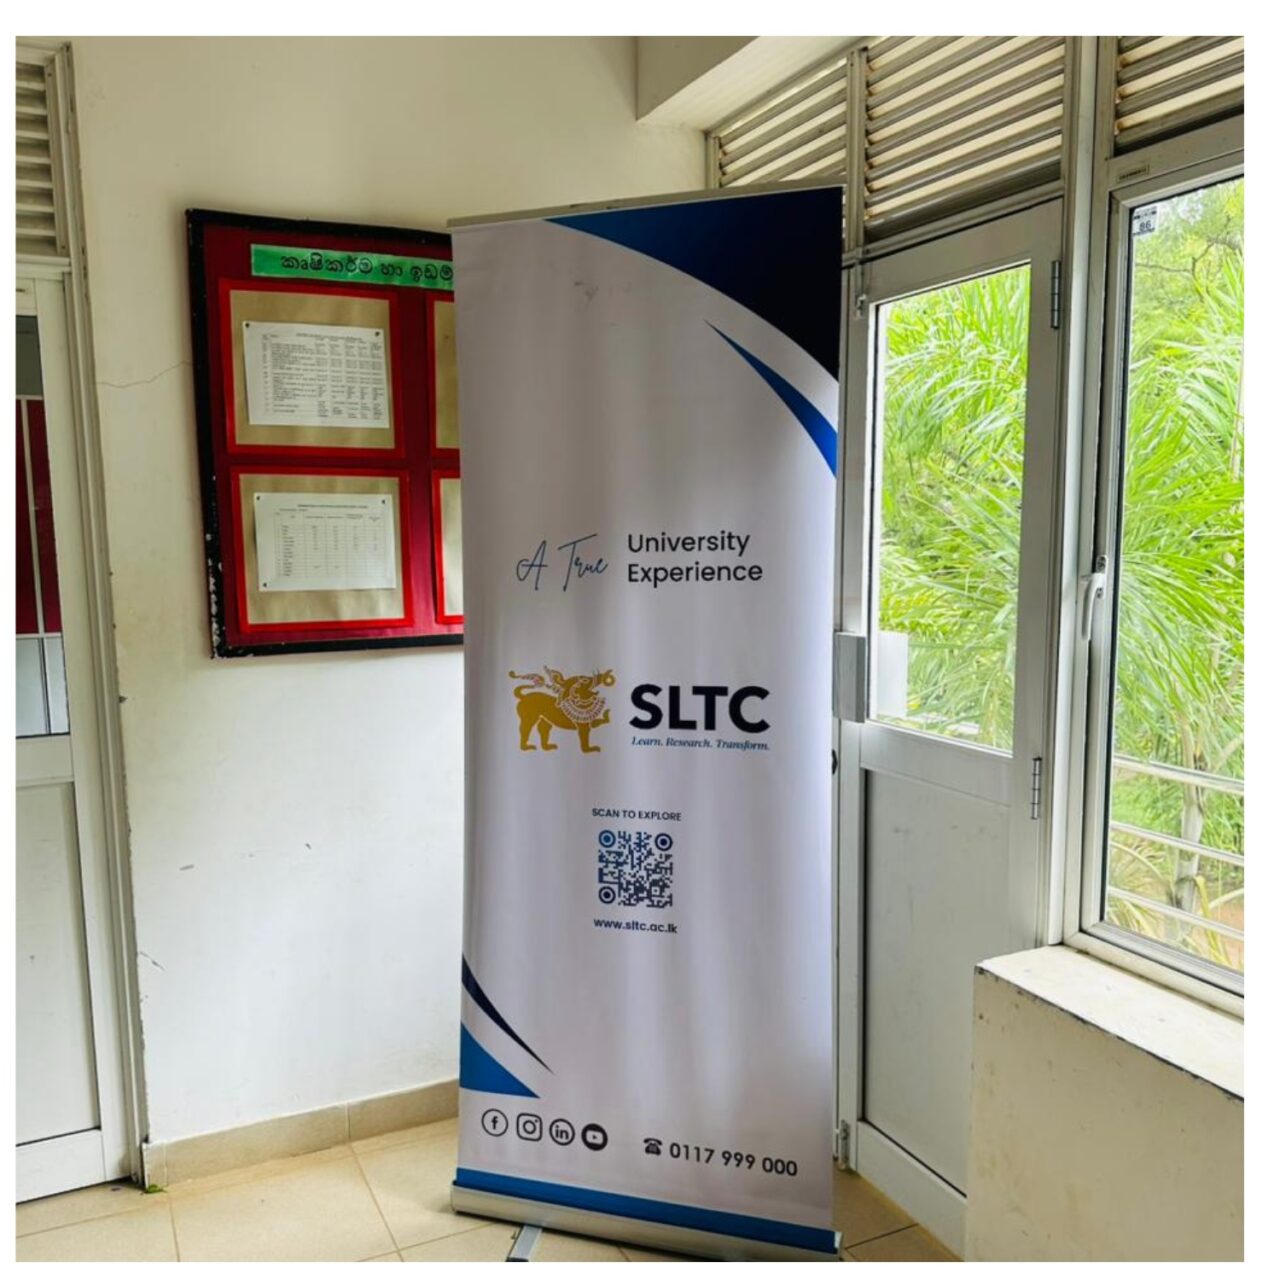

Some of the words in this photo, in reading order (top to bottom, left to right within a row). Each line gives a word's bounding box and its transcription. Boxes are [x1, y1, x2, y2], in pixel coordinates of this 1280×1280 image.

[627, 529, 751, 557] University
[516, 540, 548, 591] A
[558, 533, 609, 592] True
[627, 561, 763, 588] Experience
[629, 683, 771, 733] SLTC
[631, 736, 663, 747] Learn.
[665, 737, 712, 748] Research.
[716, 739, 770, 751] Transform.
[592, 807, 620, 818] SCAN
[622, 809, 637, 819] TO
[638, 810, 682, 822] EXPLORE
[593, 918, 678, 934] www.sltc.ac.lk
[669, 1142, 715, 1164] 0117
[721, 1150, 756, 1170] 999
[762, 1157, 798, 1177] 000
